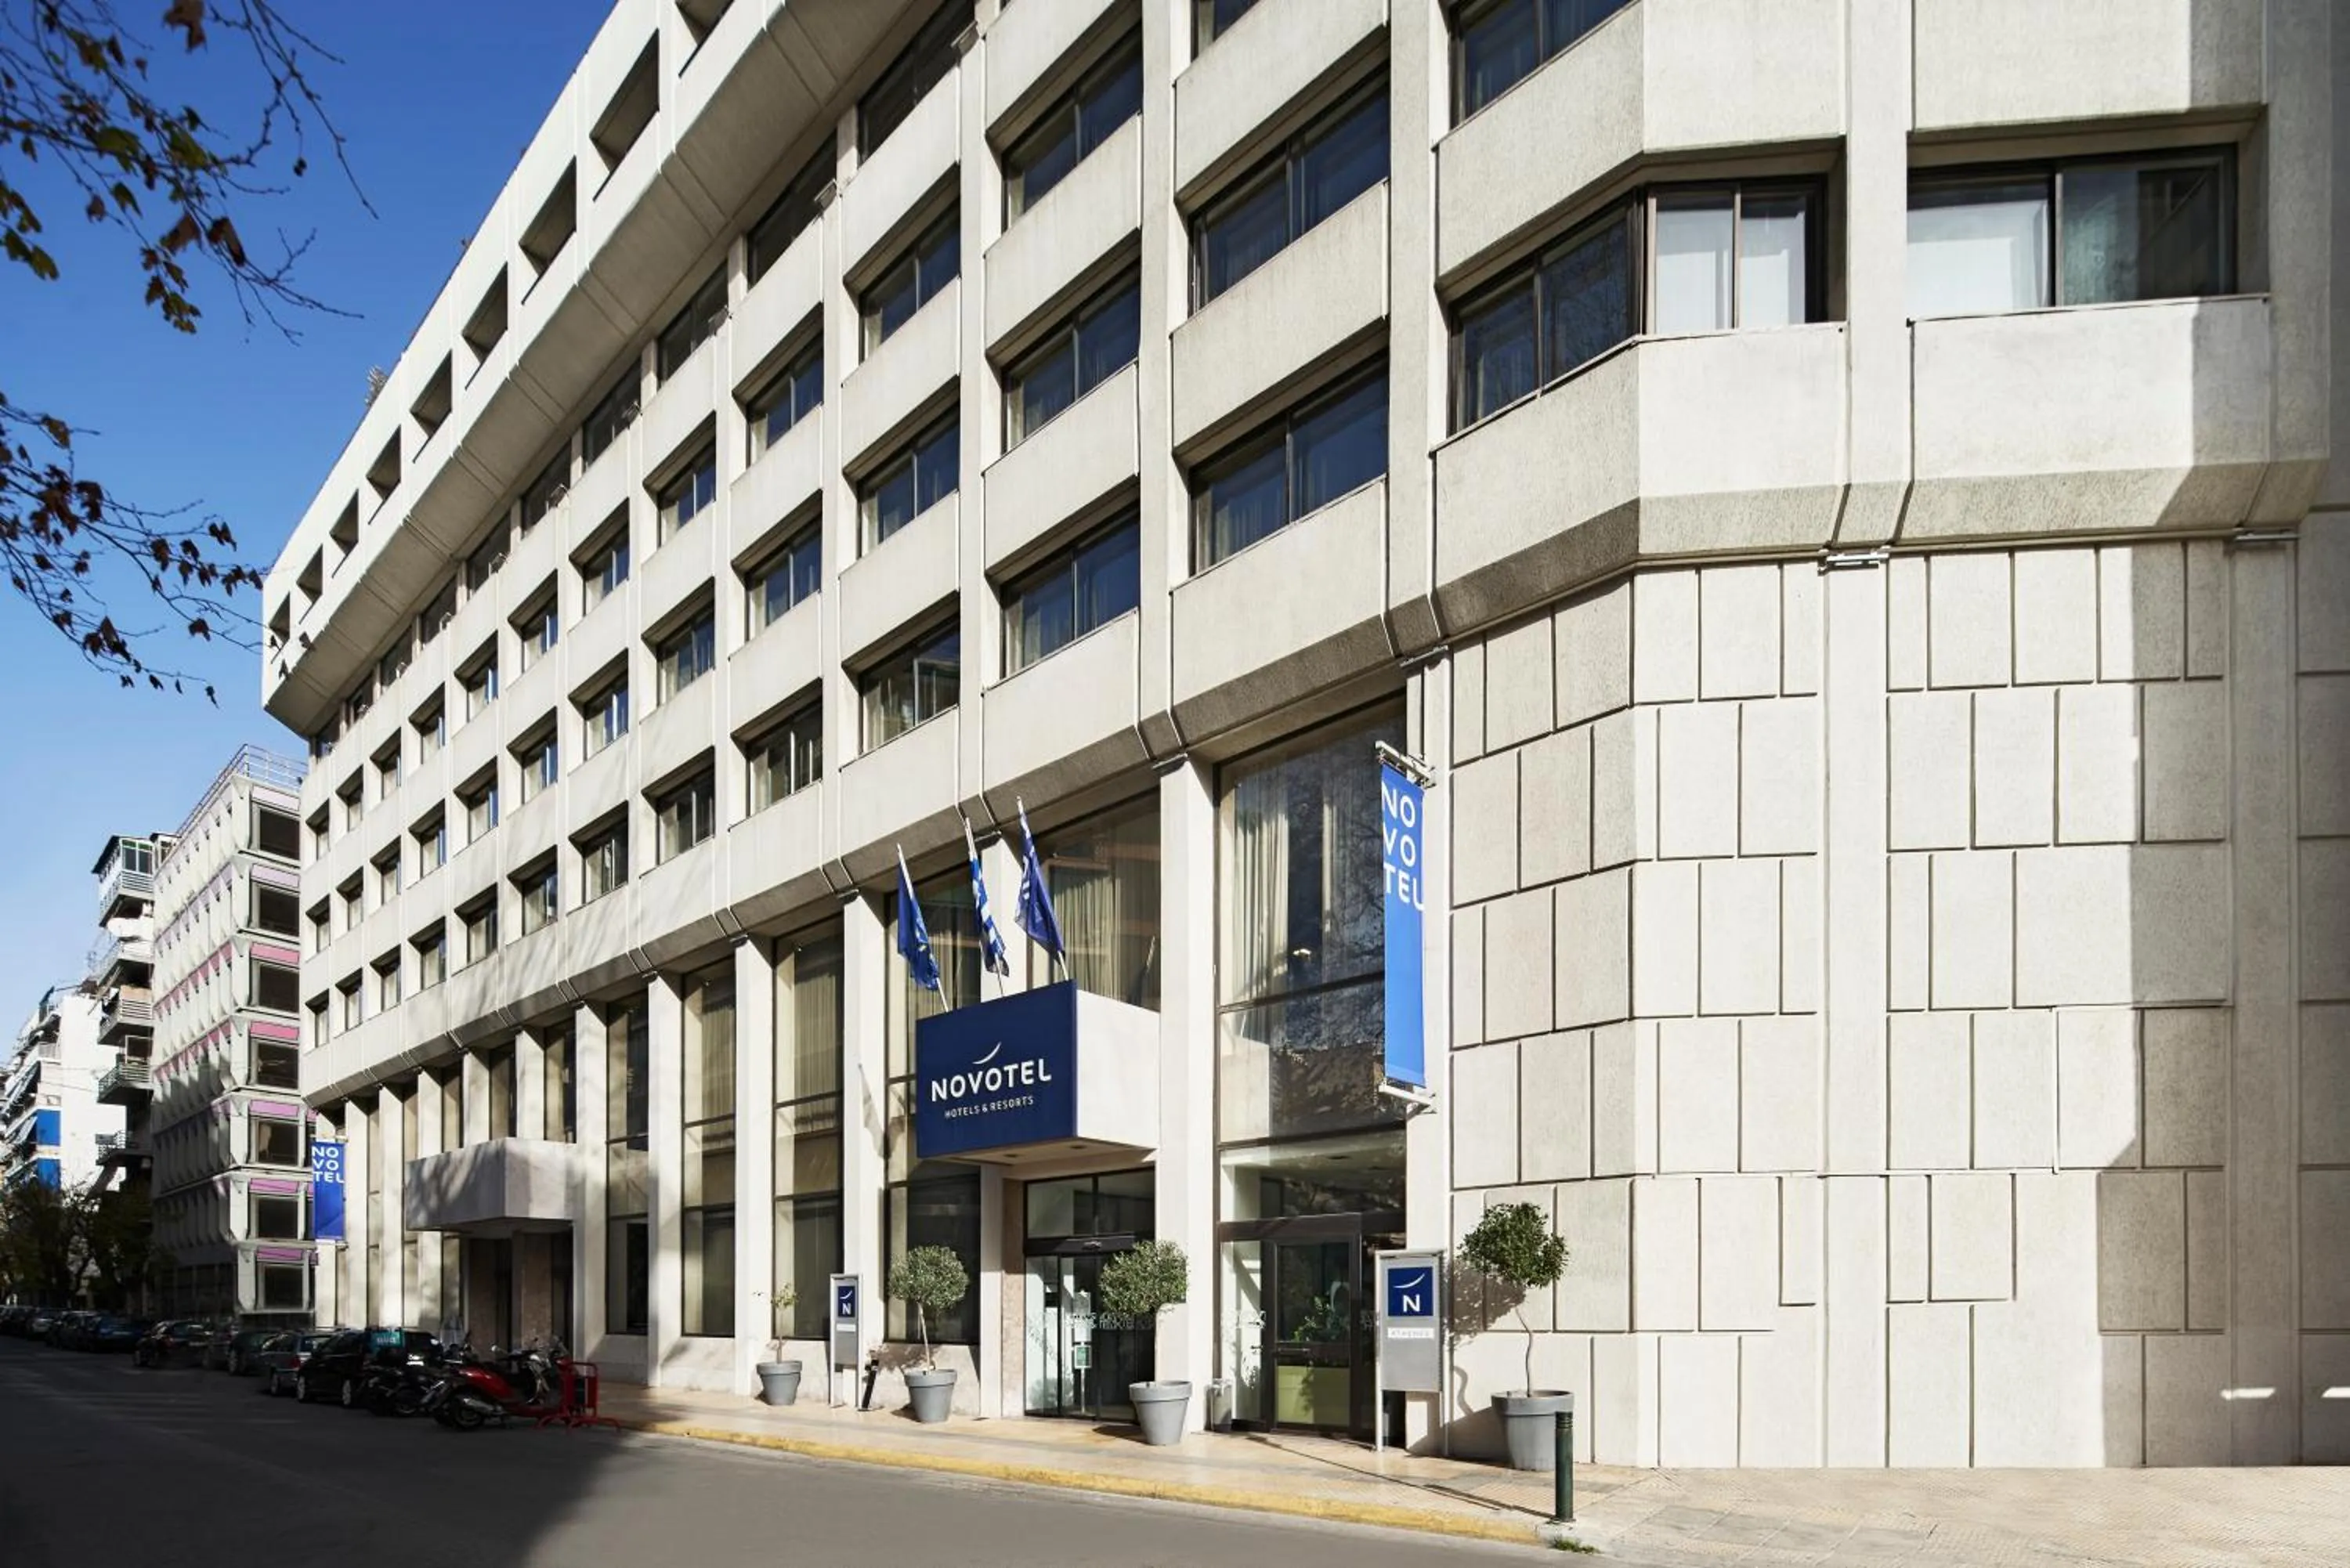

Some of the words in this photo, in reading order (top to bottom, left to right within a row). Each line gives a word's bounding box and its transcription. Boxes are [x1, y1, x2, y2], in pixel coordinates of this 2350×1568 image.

[1382, 780, 1415, 828] NO
[1383, 822, 1416, 867] VO
[1383, 864, 1424, 912] TEL
[931, 1058, 1051, 1102] NOVOTEL
[944, 1104, 980, 1119] HOTELS
[982, 1103, 989, 1113] &
[989, 1096, 1034, 1111] RESORTS
[312, 1146, 339, 1158] NO
[313, 1158, 339, 1171] VO
[313, 1171, 345, 1183] TEL
[842, 1302, 851, 1315] N
[1403, 1294, 1420, 1312] N
